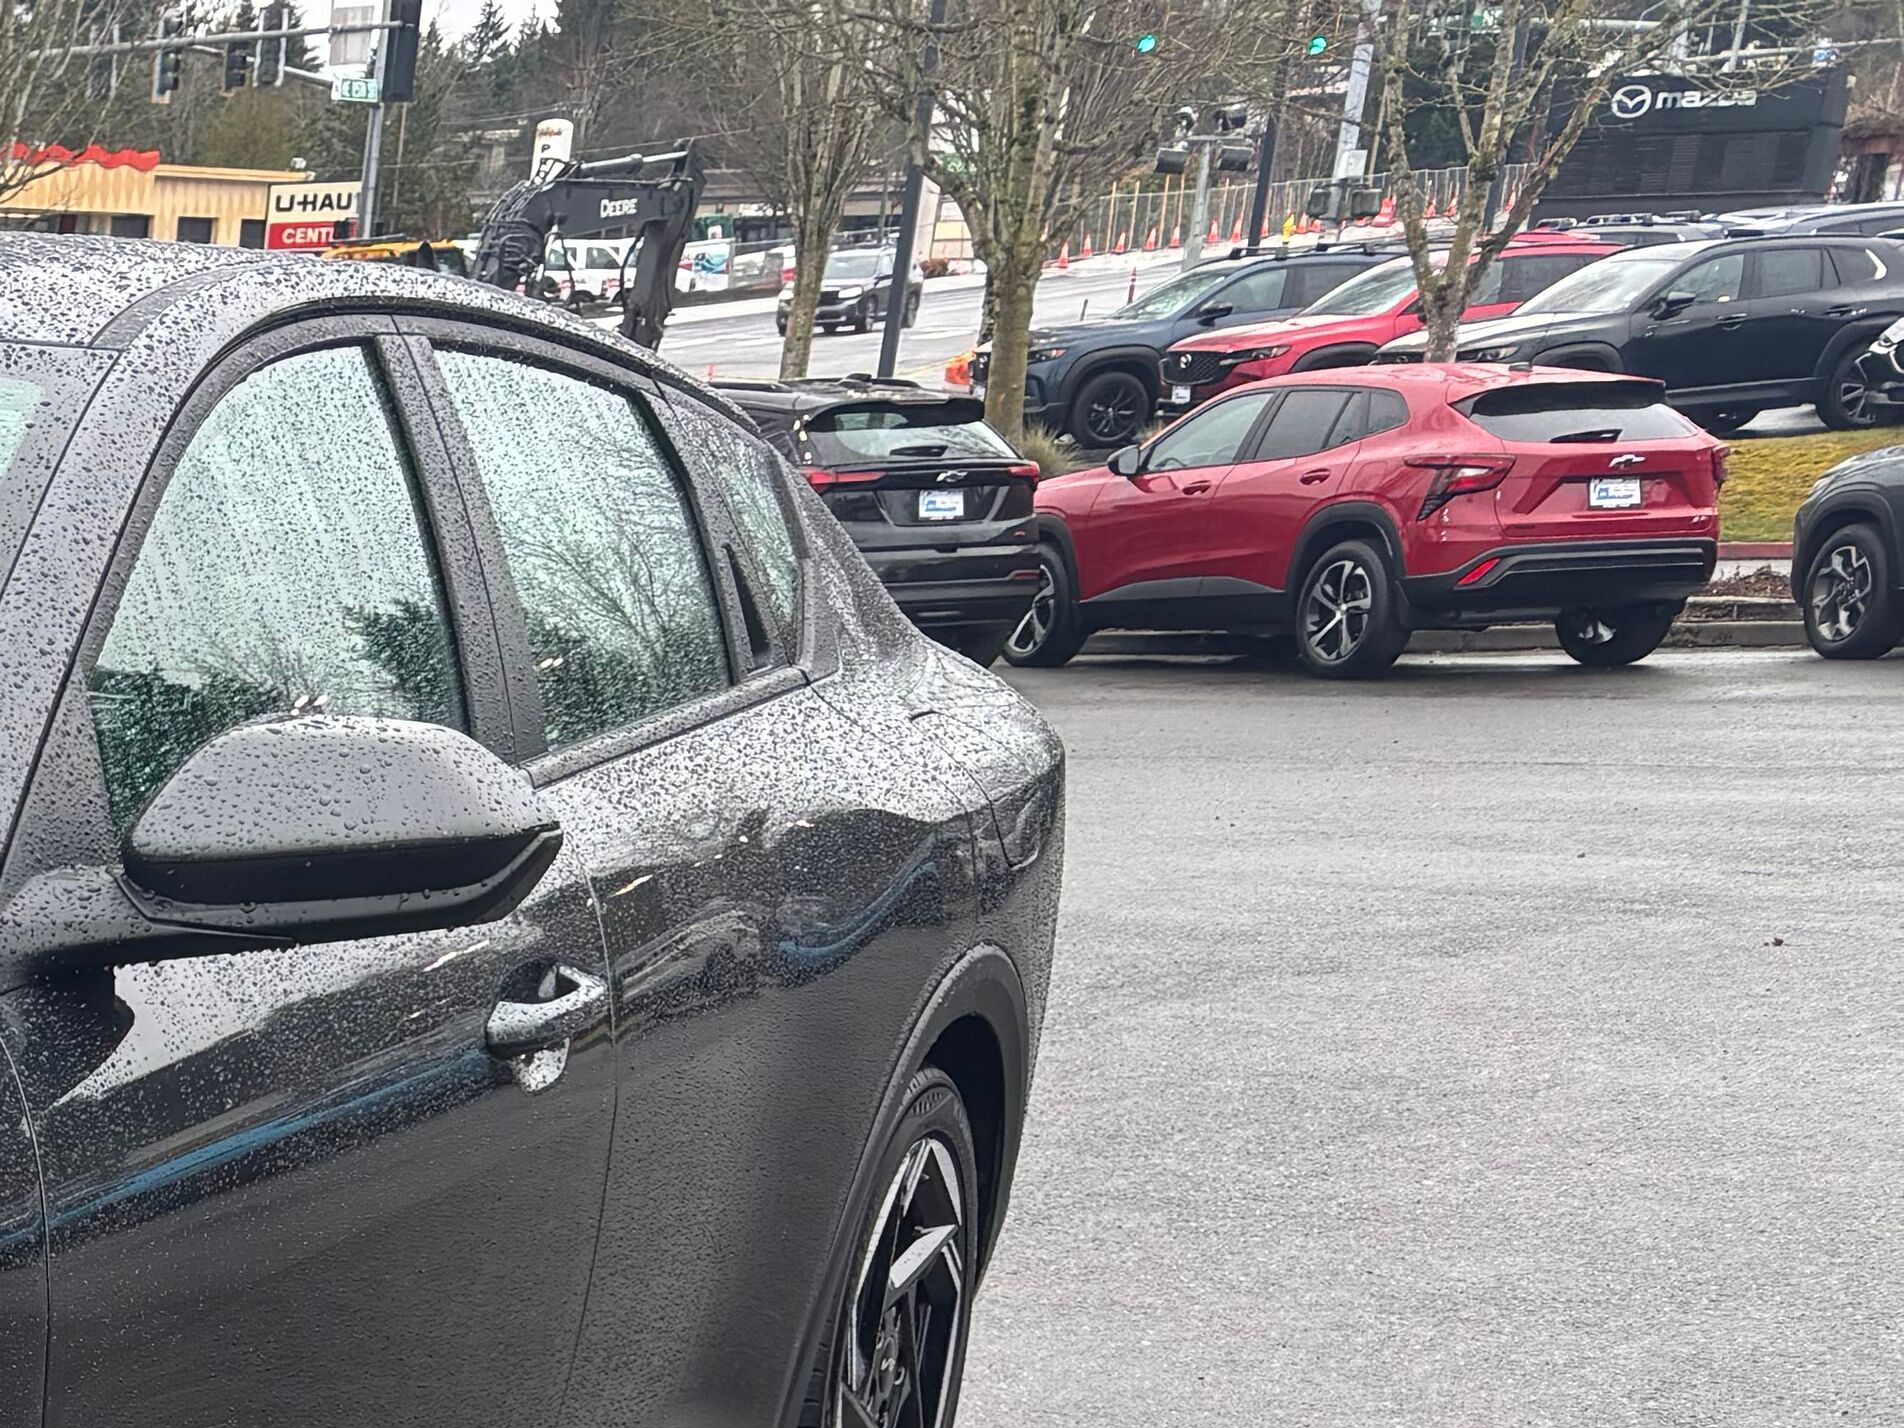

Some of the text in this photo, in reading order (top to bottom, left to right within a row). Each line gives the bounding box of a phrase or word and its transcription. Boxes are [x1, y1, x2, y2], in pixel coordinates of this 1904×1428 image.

[275, 191, 360, 212] U-HAU
[600, 198, 638, 218] DEERE
[281, 226, 335, 244] CENT
